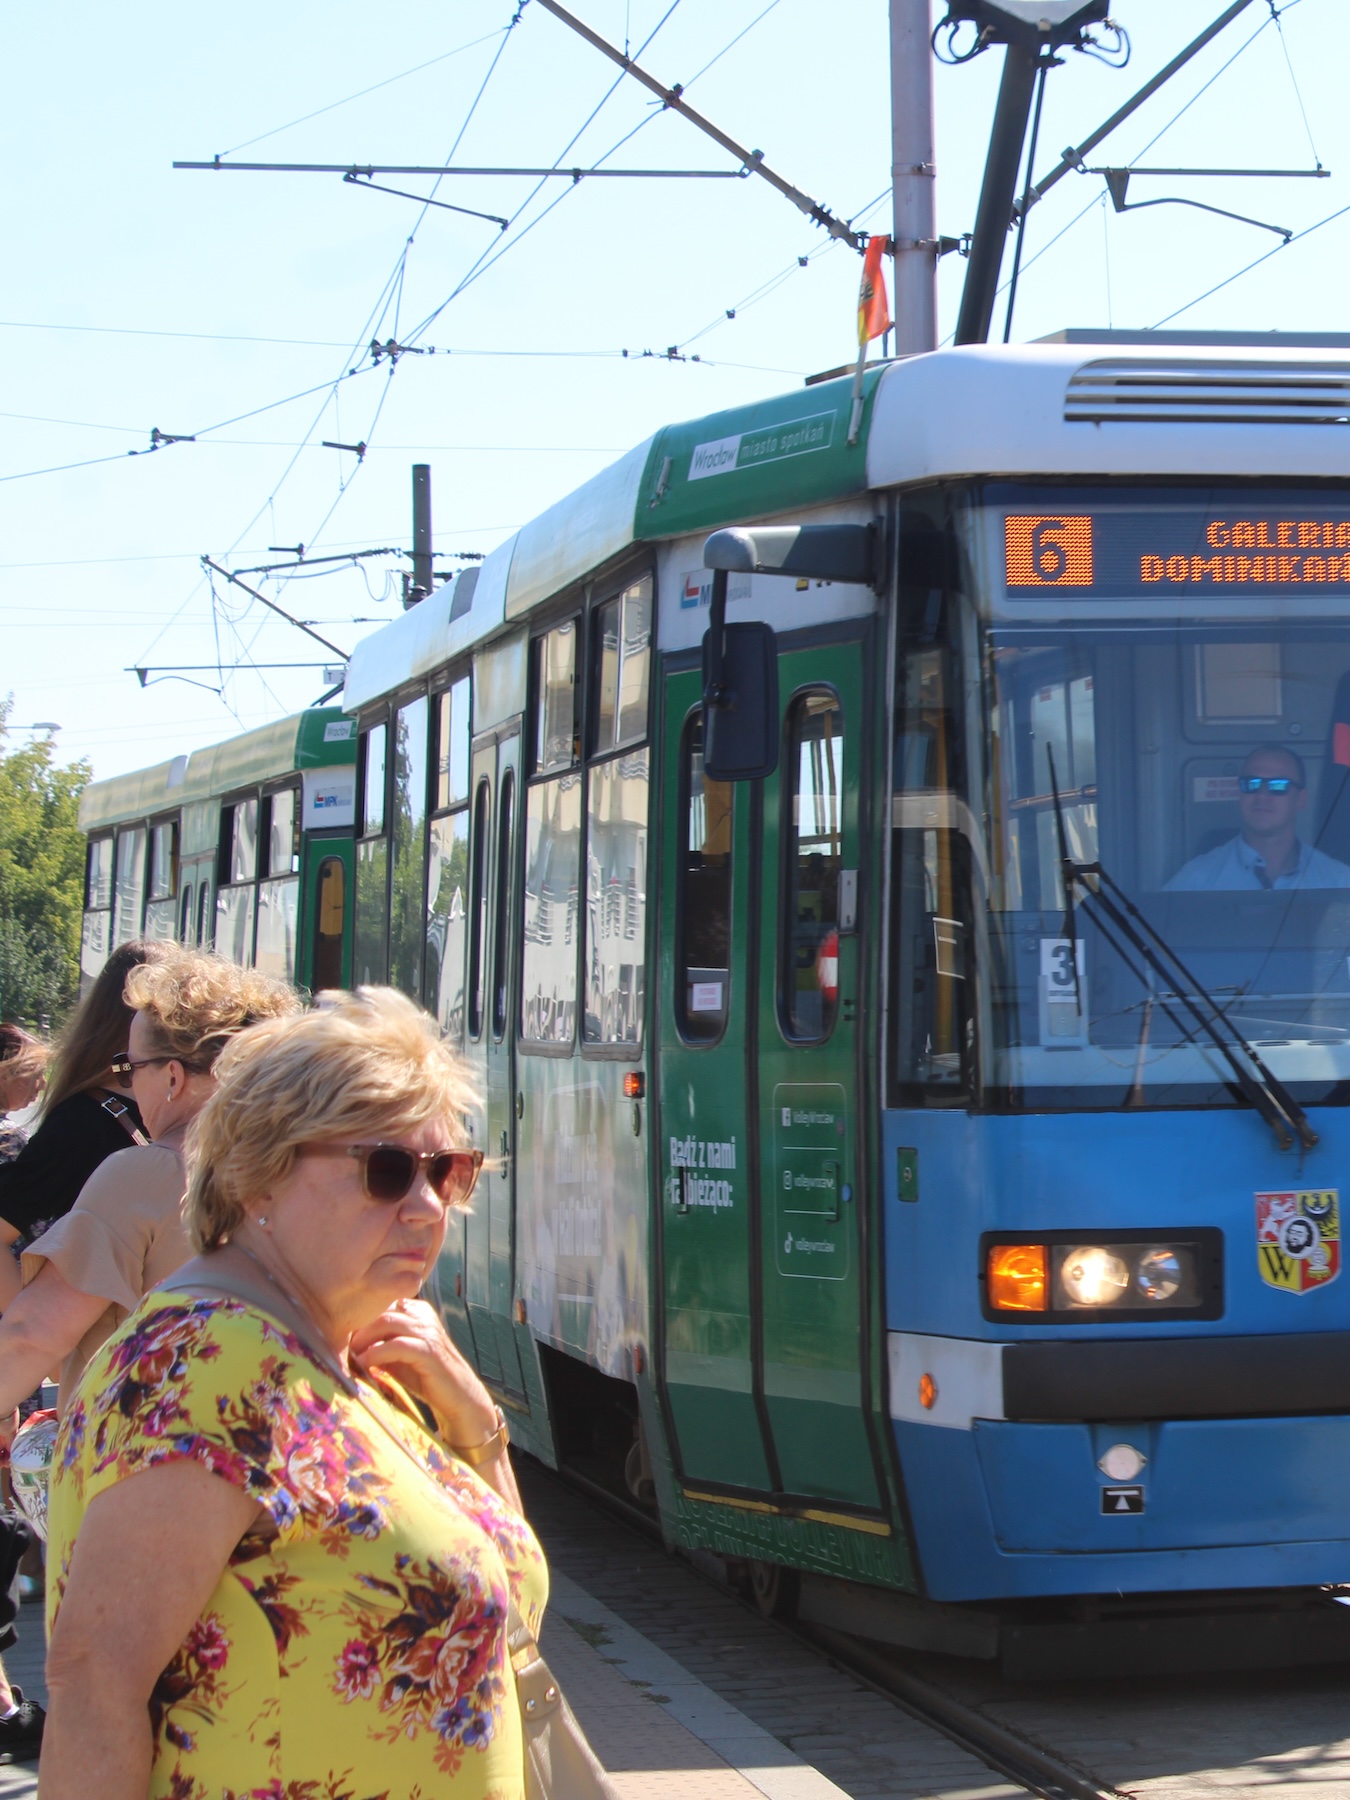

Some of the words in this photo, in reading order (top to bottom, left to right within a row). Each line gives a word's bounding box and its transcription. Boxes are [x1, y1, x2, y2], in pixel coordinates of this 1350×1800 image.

[741, 436, 778, 459] miasto
[780, 421, 825, 453] spotkań
[1031, 520, 1067, 582] 6
[1052, 946, 1074, 986] 3
[670, 1135, 697, 1168] Bądź
[698, 1142, 705, 1168] z
[707, 1136, 736, 1169] nami
[687, 1172, 734, 1215] bieżąco:
